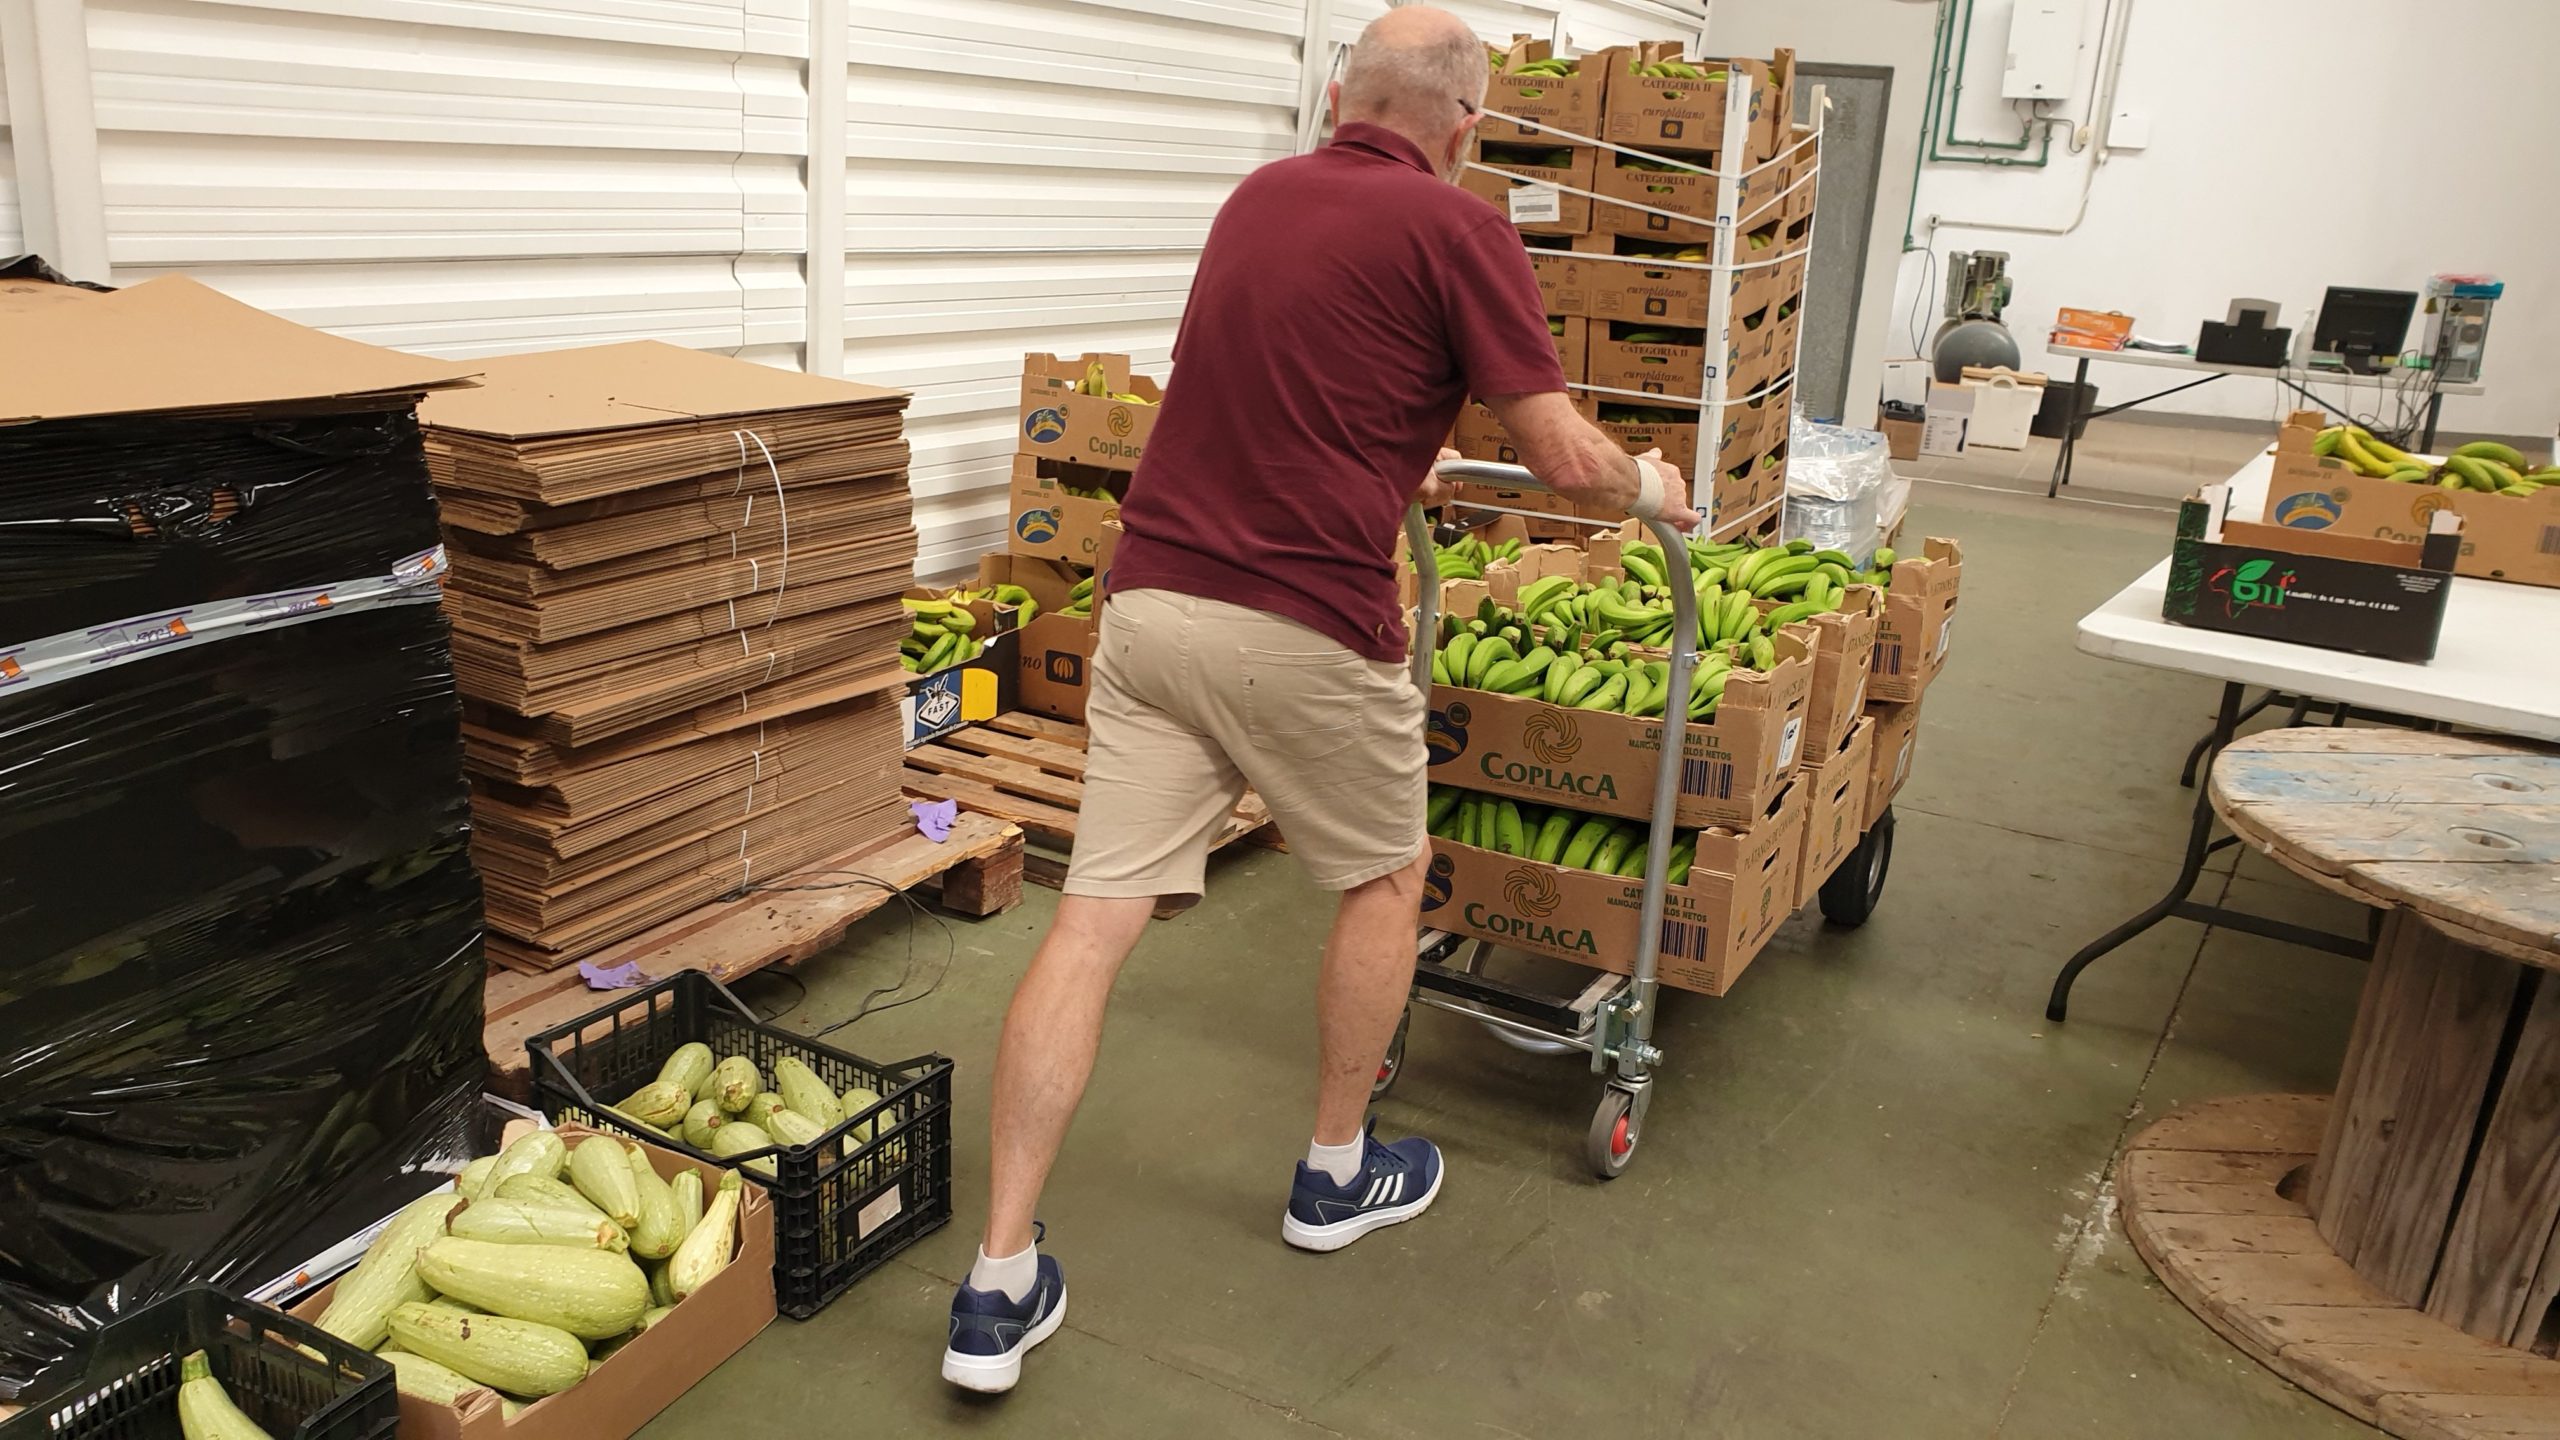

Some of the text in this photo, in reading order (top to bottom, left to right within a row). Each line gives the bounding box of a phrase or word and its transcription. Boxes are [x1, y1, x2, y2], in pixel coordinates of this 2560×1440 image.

[1500, 77, 1564, 89] CATEGORIA II
[1641, 79, 1711, 92] CATEGORIA II
[1502, 102, 1560, 117] europlátano
[1642, 106, 1705, 121] europlátano
[1550, 171, 1557, 180] II
[1626, 172, 1696, 186] CATEGORIA II
[1627, 285, 1688, 299] europlátano
[1620, 344, 1688, 357] CATEGORIA II
[1623, 369, 1684, 383] europlátano
[1605, 426, 1672, 435] CATEGORIA II
[1088, 436, 1142, 460] Coplac
[928, 700, 950, 716] FAST
[1706, 735, 1719, 749] II
[1706, 750, 1732, 761] NETOS
[1682, 896, 1697, 910] II
[1682, 911, 1707, 923] NETOS
